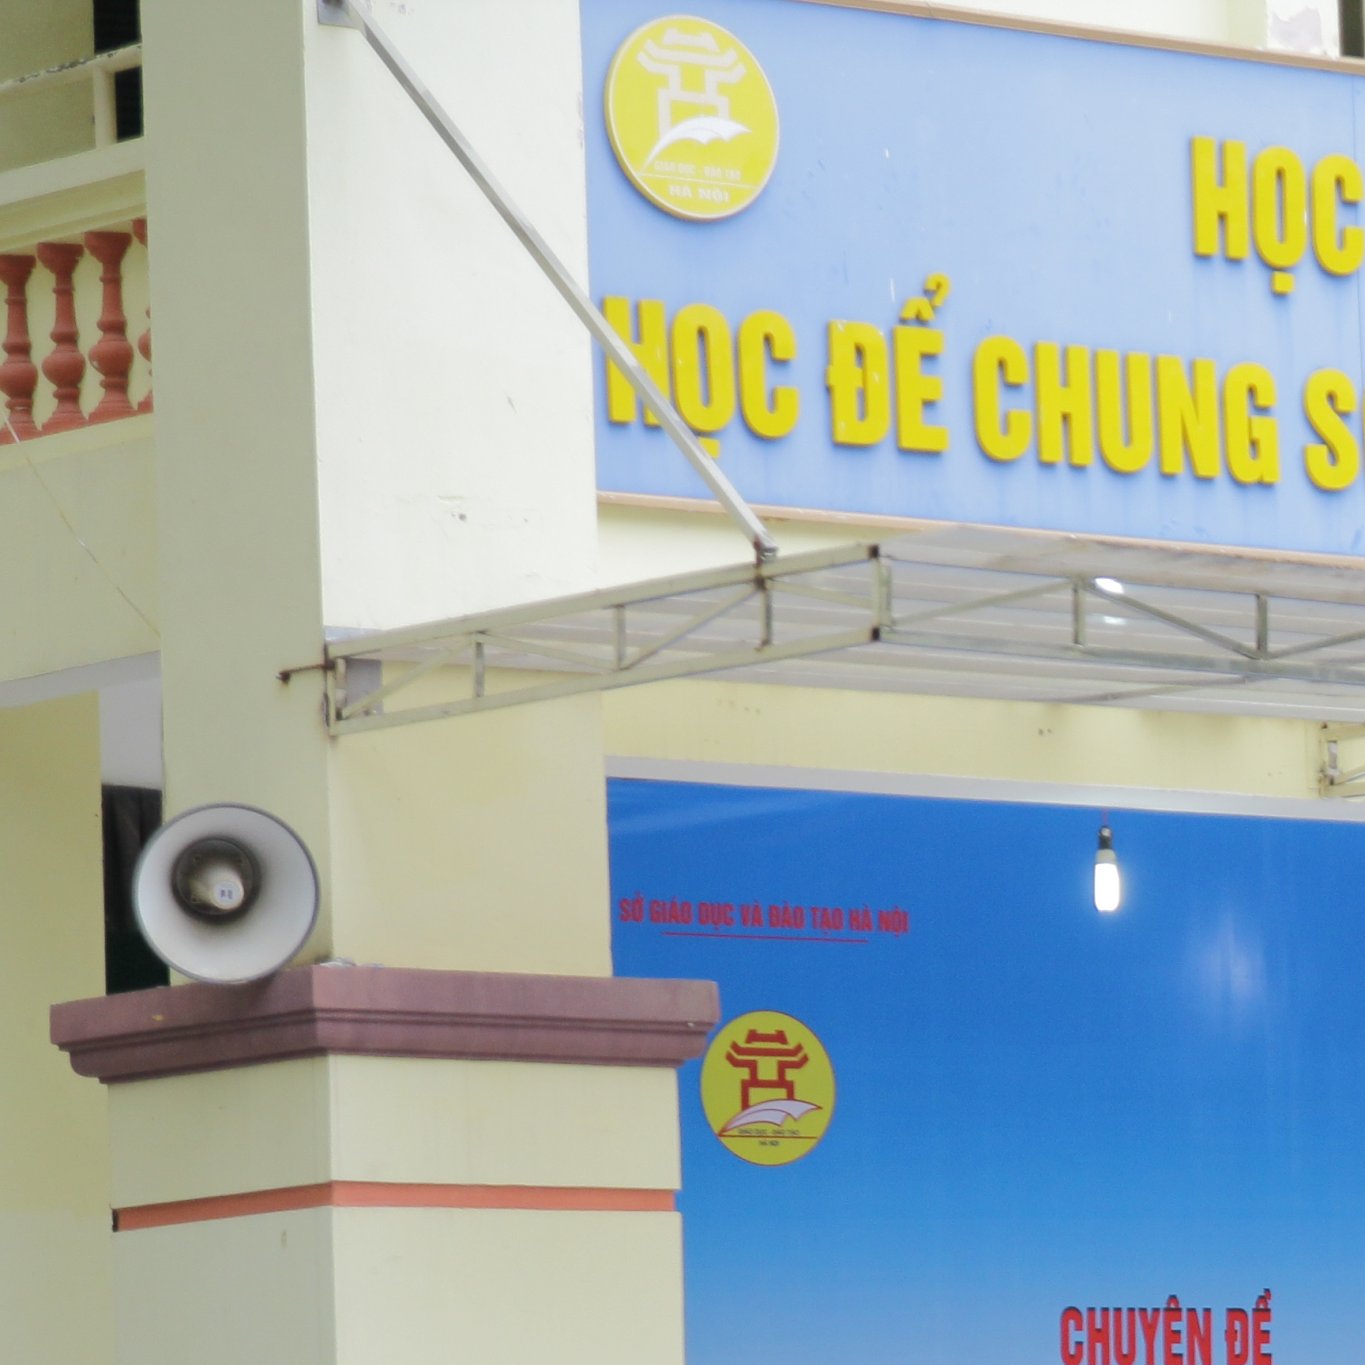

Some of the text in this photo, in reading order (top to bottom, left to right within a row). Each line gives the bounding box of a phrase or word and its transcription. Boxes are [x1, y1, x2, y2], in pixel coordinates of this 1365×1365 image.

[1191, 135, 1365, 295] HỌC
[601, 296, 798, 457] HỌC
[826, 274, 951, 453] ĐỂ
[973, 336, 1279, 487] CHUNG
[649, 896, 693, 925] GIÁO
[698, 902, 736, 931] DỤC
[740, 899, 764, 928] VÀ
[768, 900, 805, 930] ĐÀO
[811, 905, 844, 935] TẠO
[849, 903, 873, 932] HÀ
[878, 905, 910, 938] NỘI
